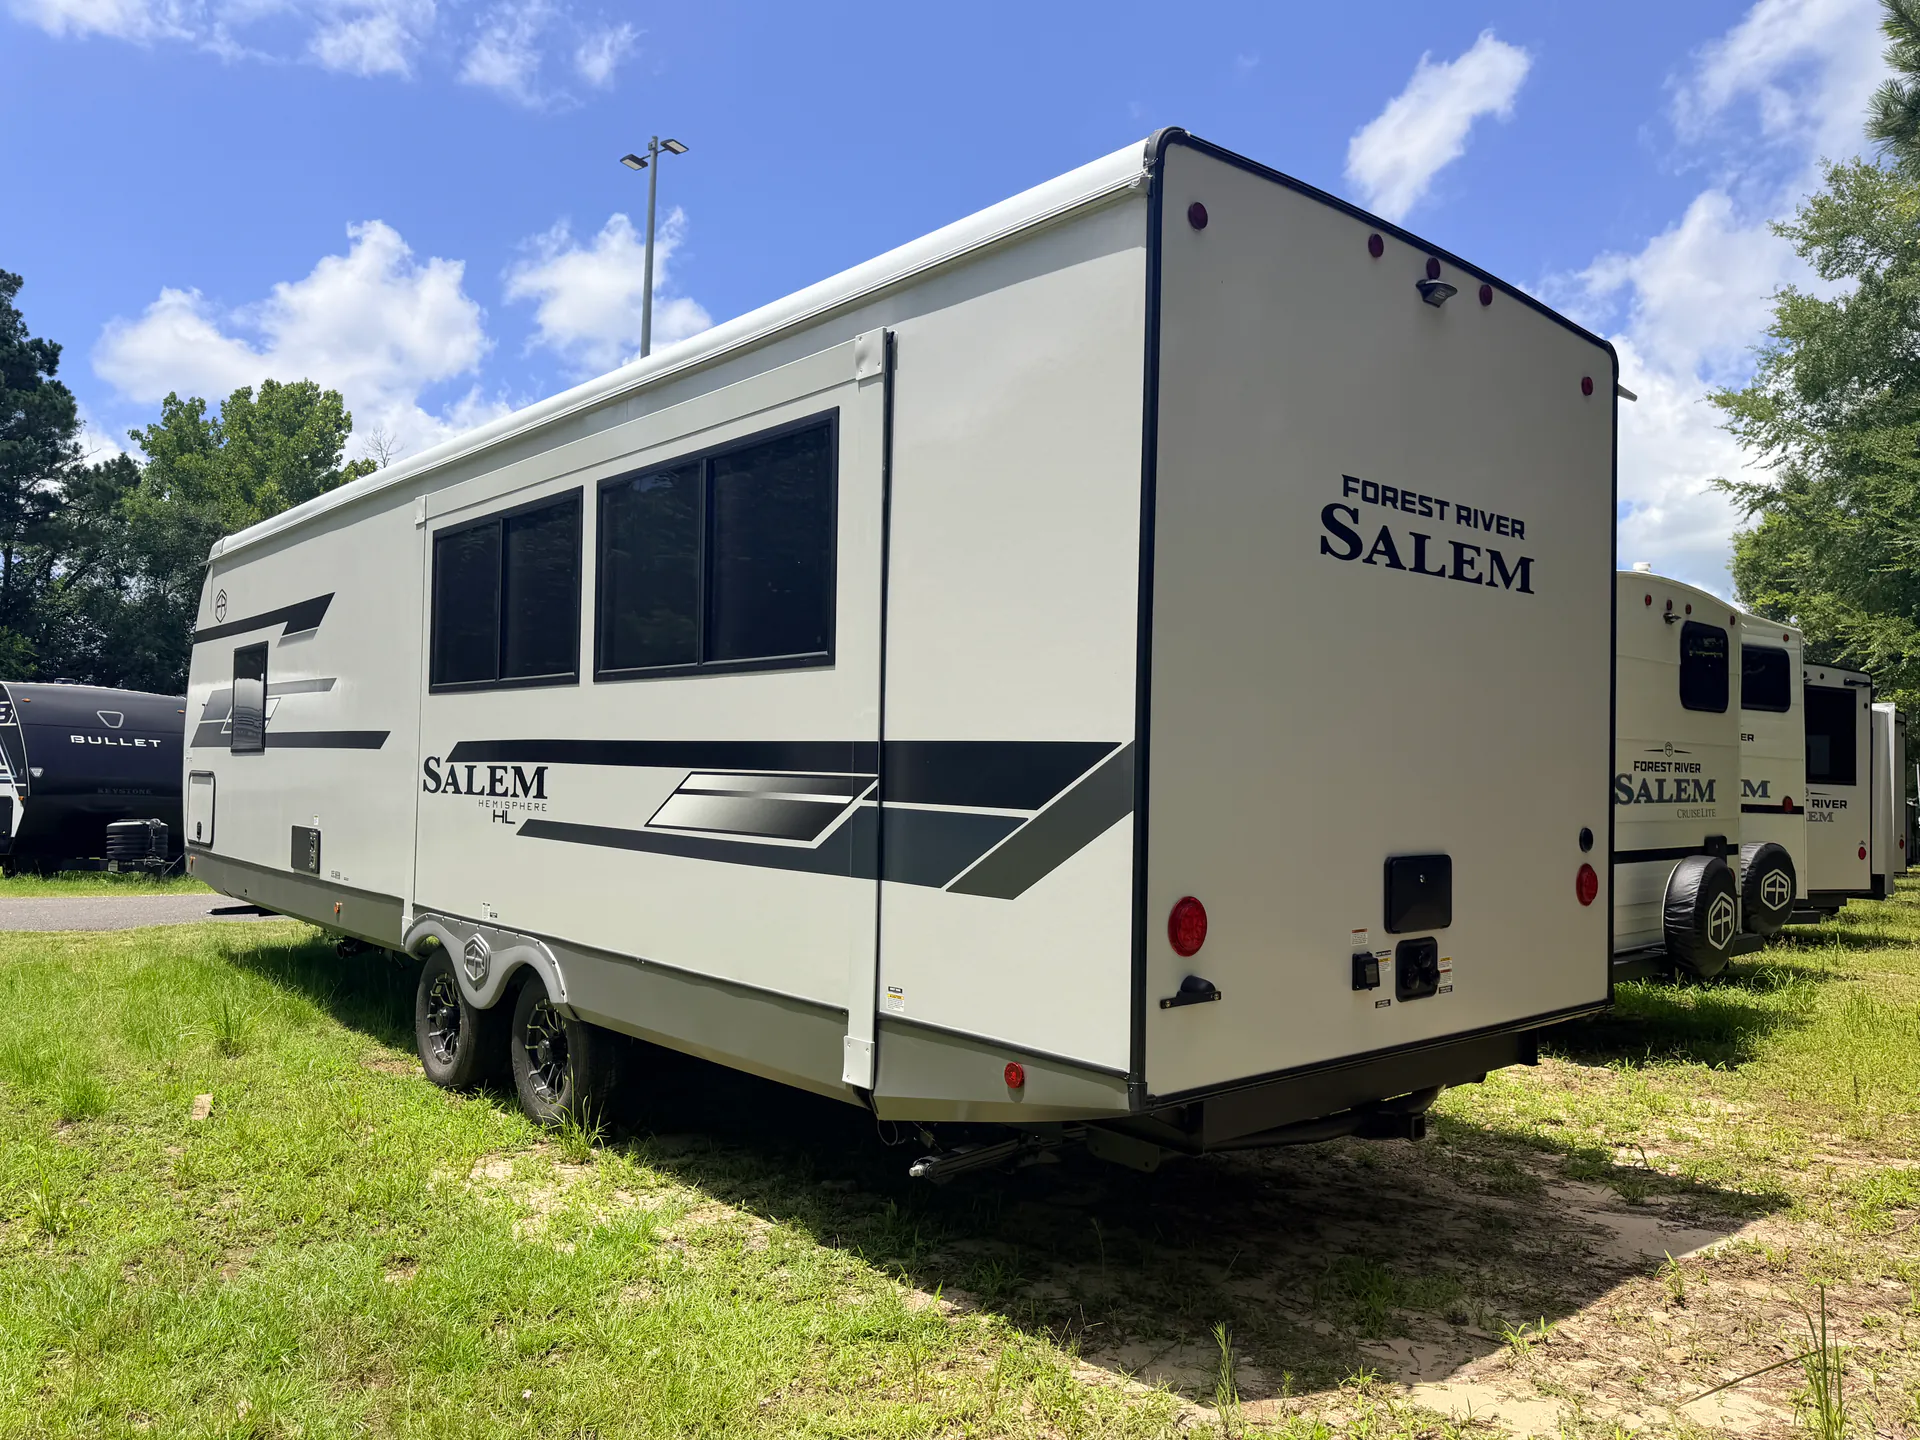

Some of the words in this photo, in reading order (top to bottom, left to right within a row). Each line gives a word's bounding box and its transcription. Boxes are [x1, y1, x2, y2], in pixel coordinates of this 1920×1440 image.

[1341, 474, 1450, 521] FOREST
[1455, 503, 1526, 540] RIVER
[1320, 502, 1535, 595] SALEM
[70, 735, 161, 748] BULLET
[1633, 760, 1673, 772] FOREST
[1674, 762, 1702, 774] RIVER
[422, 756, 549, 800] SALEM
[97, 787, 152, 795] KEYSTONE
[1614, 773, 1717, 806] SALEM
[478, 799, 548, 812] HEMISPHERE
[1811, 799, 1848, 809] RIVER
[492, 809, 516, 825] HL
